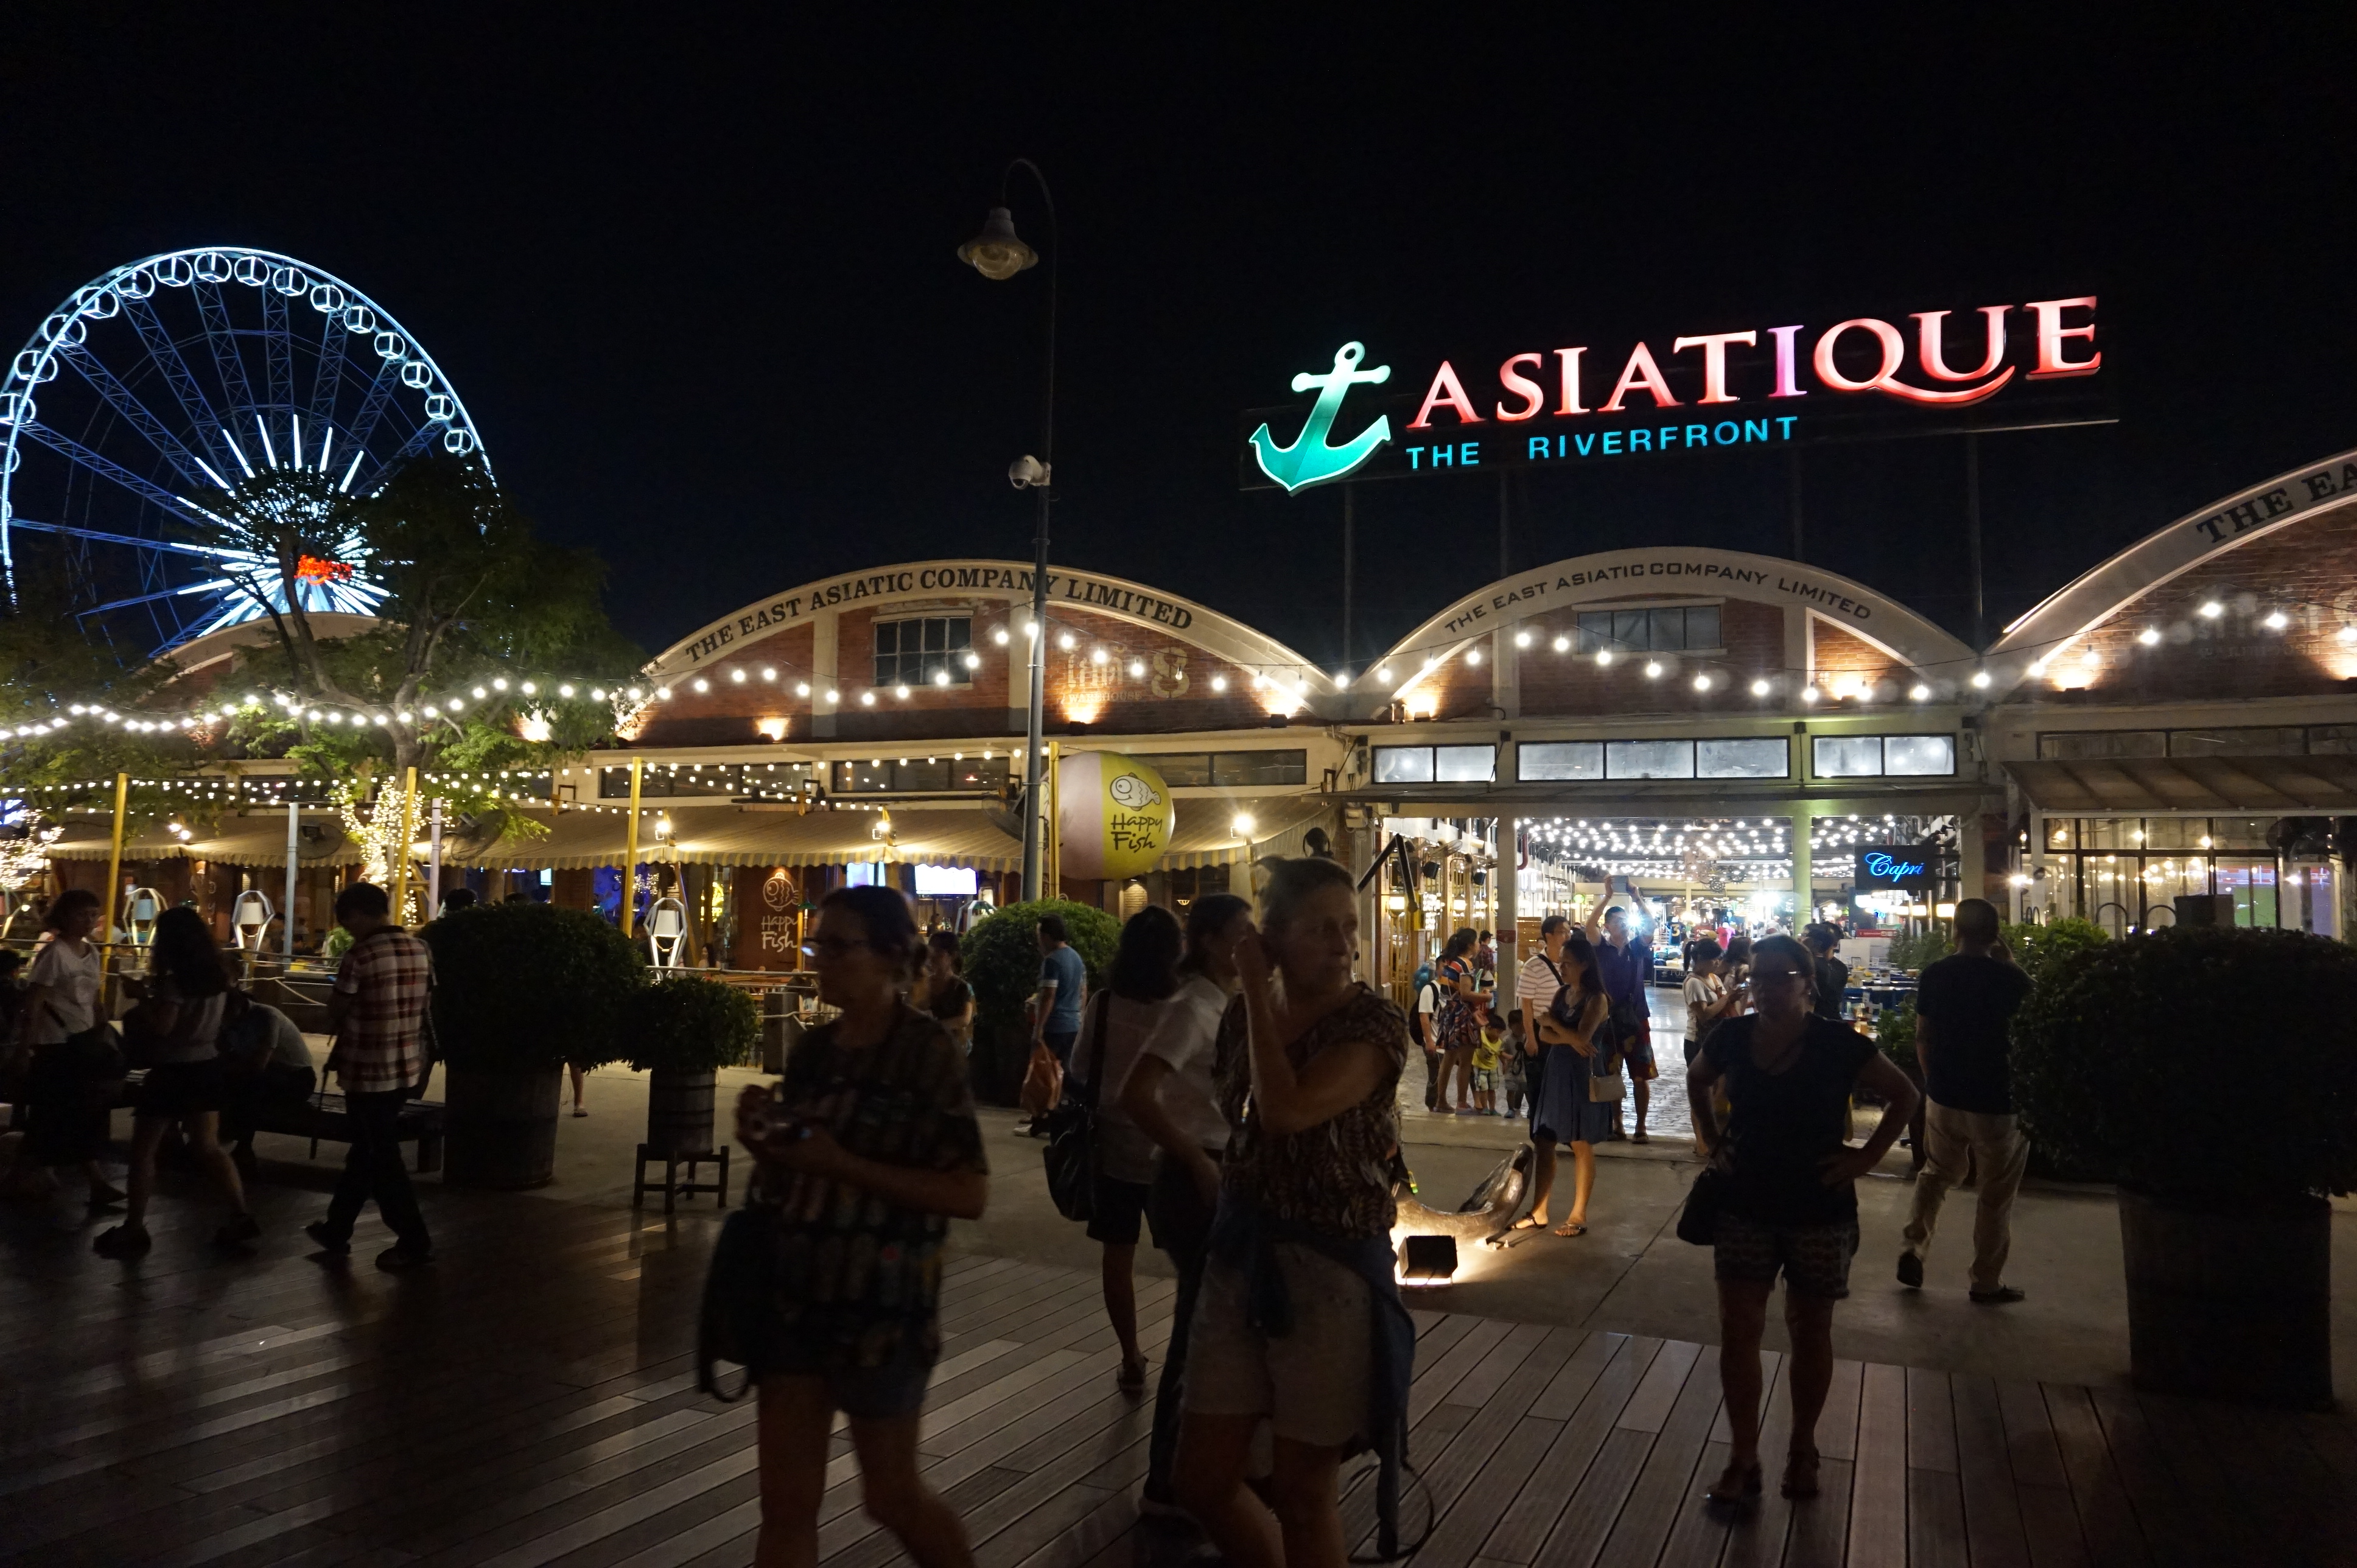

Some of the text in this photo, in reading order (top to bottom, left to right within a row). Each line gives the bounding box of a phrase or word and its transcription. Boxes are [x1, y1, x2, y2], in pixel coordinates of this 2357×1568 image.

[1406, 295, 2102, 429] ASIATIQUE
[1406, 416, 1799, 469] THE RIVERFRONT
[2197, 487, 2294, 544] THE
[685, 568, 1193, 662] THE EAST ASIATIC COMPANY LIMITED
[1445, 562, 1871, 633] THE EAST ASIATIC COMPANY LIMITED
[1068, 691, 1143, 703] WAREHOUSE
[1151, 647, 1190, 698] 8
[1110, 813, 1163, 833] Happy
[1110, 831, 1156, 853] Fish
[1865, 852, 1925, 882] Capri
[762, 931, 798, 953] Fish
